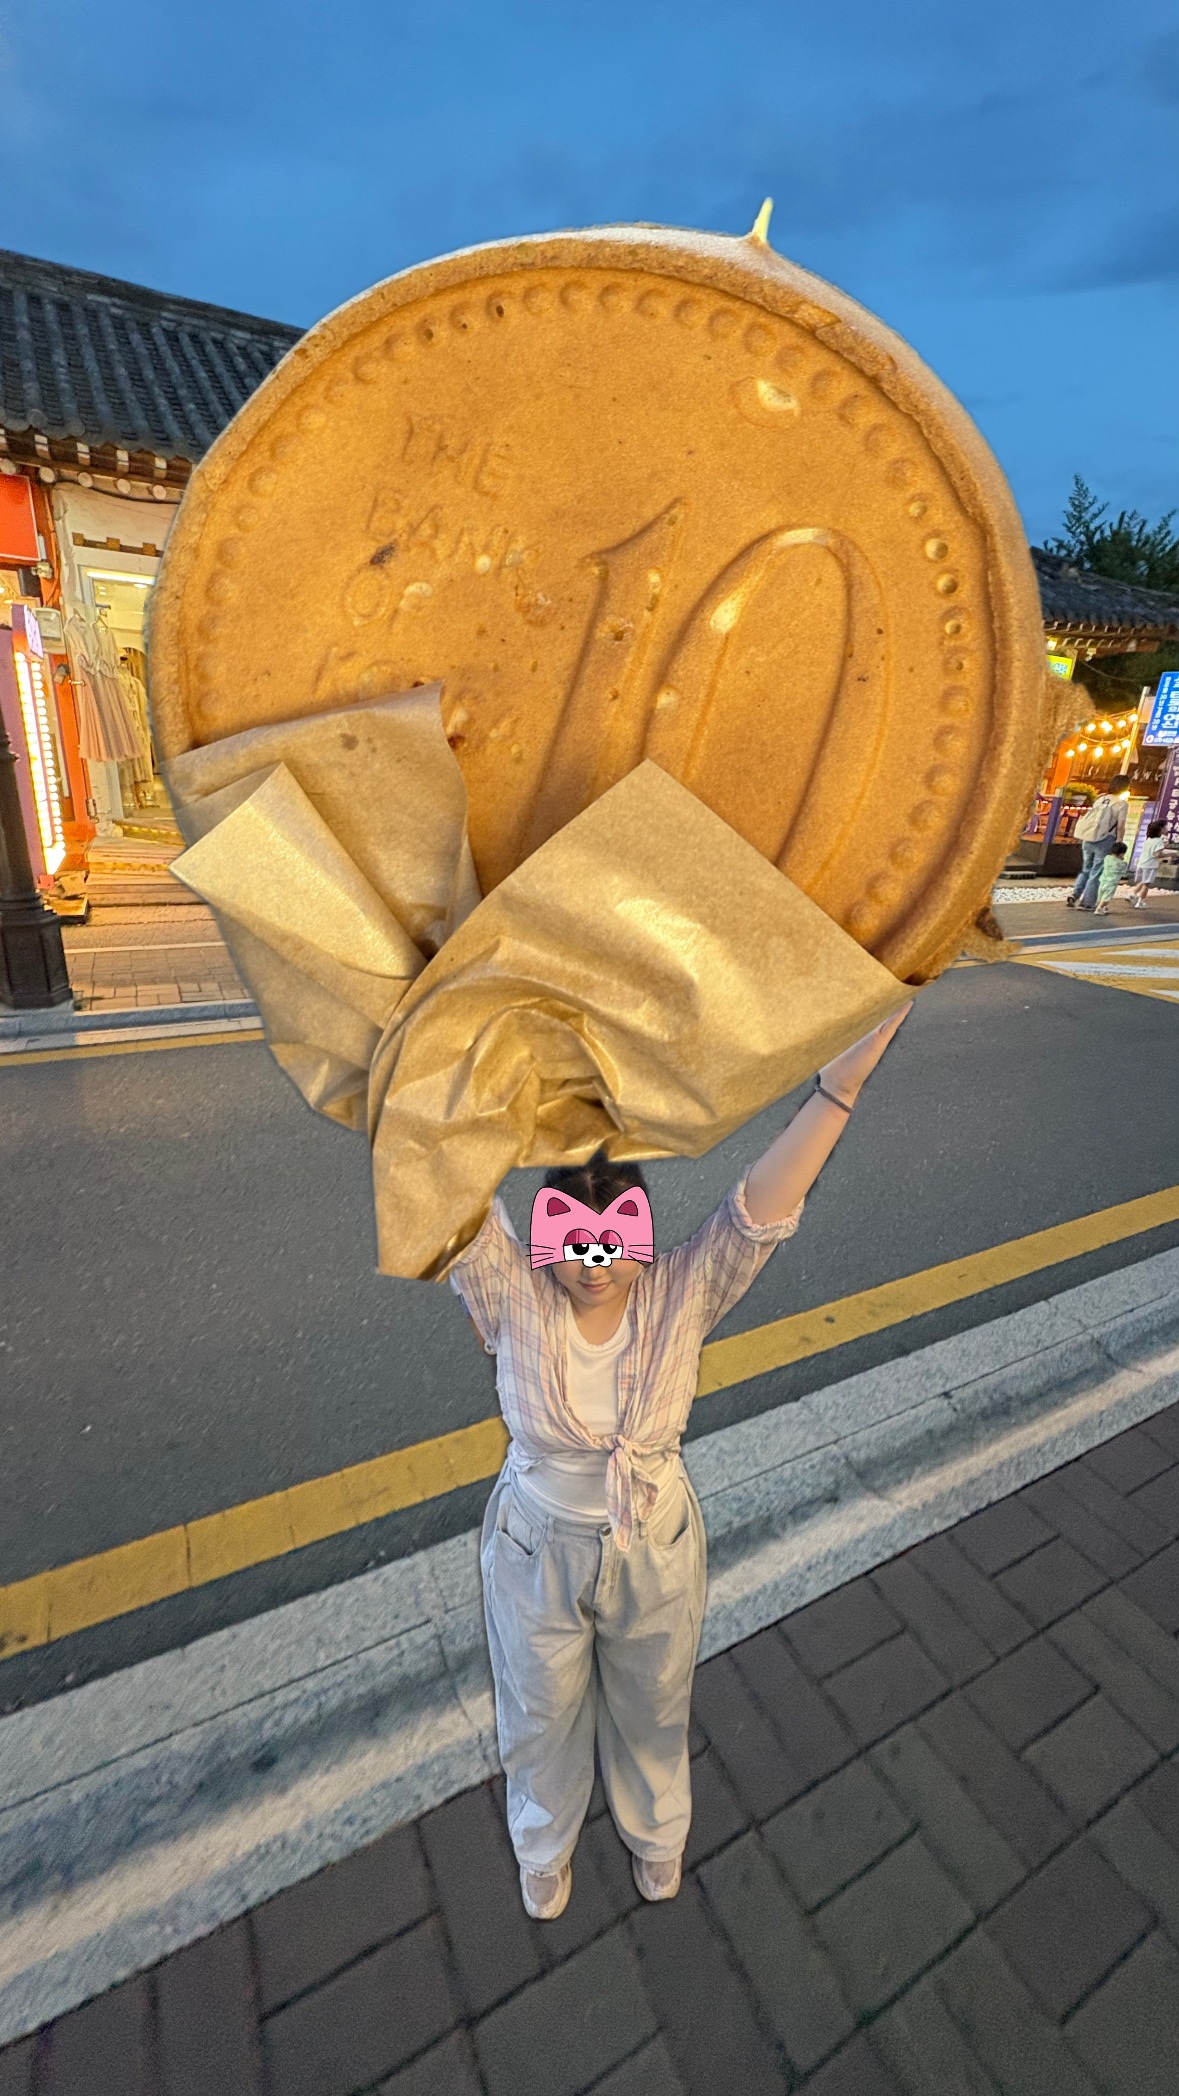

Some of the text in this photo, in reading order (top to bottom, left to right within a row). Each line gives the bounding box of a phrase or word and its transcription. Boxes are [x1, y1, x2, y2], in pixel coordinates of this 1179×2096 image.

[401, 413, 513, 500] THE
[364, 488, 543, 593] BANK
[484, 497, 891, 890] 10
